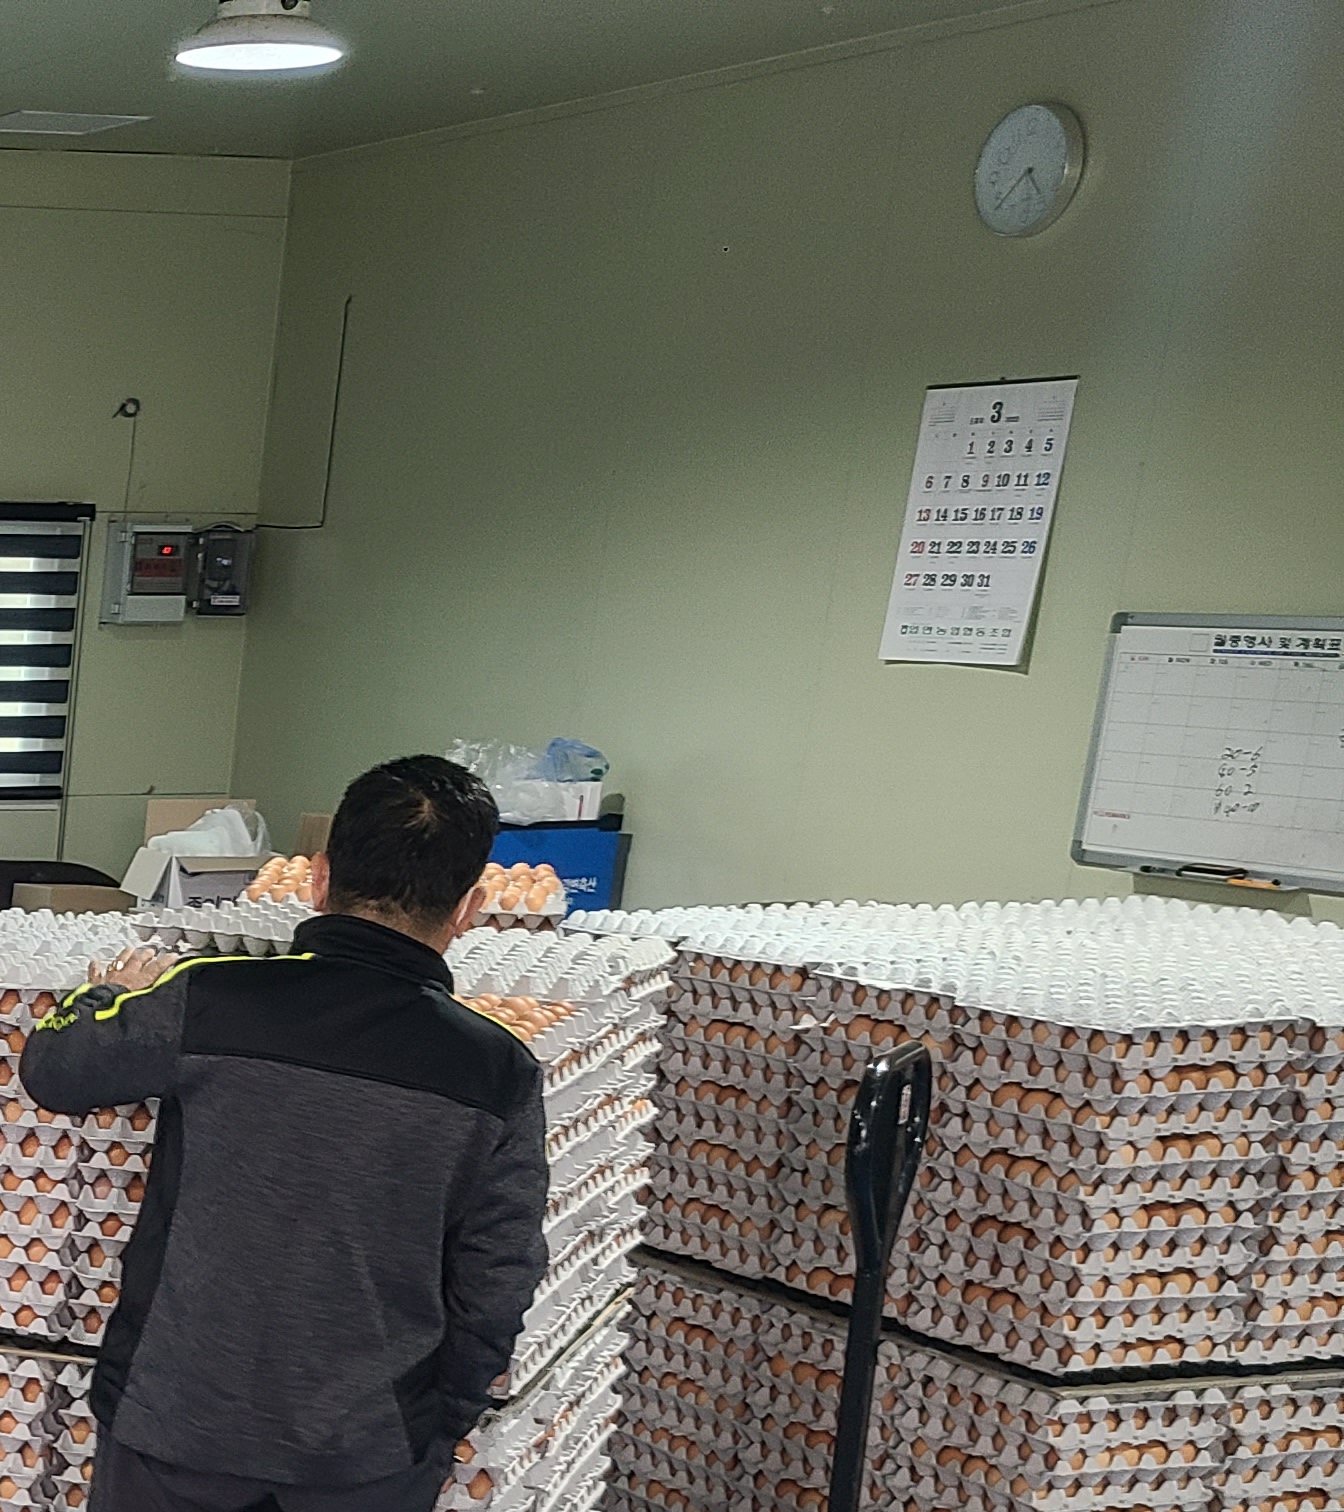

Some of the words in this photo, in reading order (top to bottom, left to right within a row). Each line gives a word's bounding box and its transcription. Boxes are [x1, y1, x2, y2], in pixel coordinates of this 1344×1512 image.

[989, 401, 1005, 424] 3
[967, 441, 975, 454] 1
[987, 440, 996, 453] 2
[1004, 440, 1013, 453] 3
[1024, 439, 1033, 452] 4
[1044, 438, 1054, 451] 5
[925, 476, 933, 489] 6
[943, 476, 952, 488] 7
[961, 475, 970, 488] 8
[981, 475, 989, 487] 9
[995, 474, 1010, 487] 10
[1015, 473, 1029, 486] 11
[1035, 472, 1050, 486] 12
[916, 508, 931, 521] 13
[934, 508, 947, 521] 14
[952, 508, 968, 521] 15
[972, 507, 986, 521] 16
[989, 507, 1004, 520] 17
[1008, 507, 1023, 520] 18
[1028, 506, 1043, 520] 19
[910, 541, 925, 554] 20
[928, 541, 941, 554] 21
[946, 541, 962, 554] 22
[966, 541, 981, 554] 23
[983, 541, 997, 554] 24
[1001, 541, 1016, 554] 25
[1021, 541, 1037, 554] 26
[904, 573, 920, 586] 27
[922, 573, 936, 586] 28
[941, 574, 957, 587] 29
[961, 574, 975, 587] 30
[977, 574, 991, 588] 31
[1278, 637, 1292, 649] 및
[1296, 637, 1343, 651] 계획표
